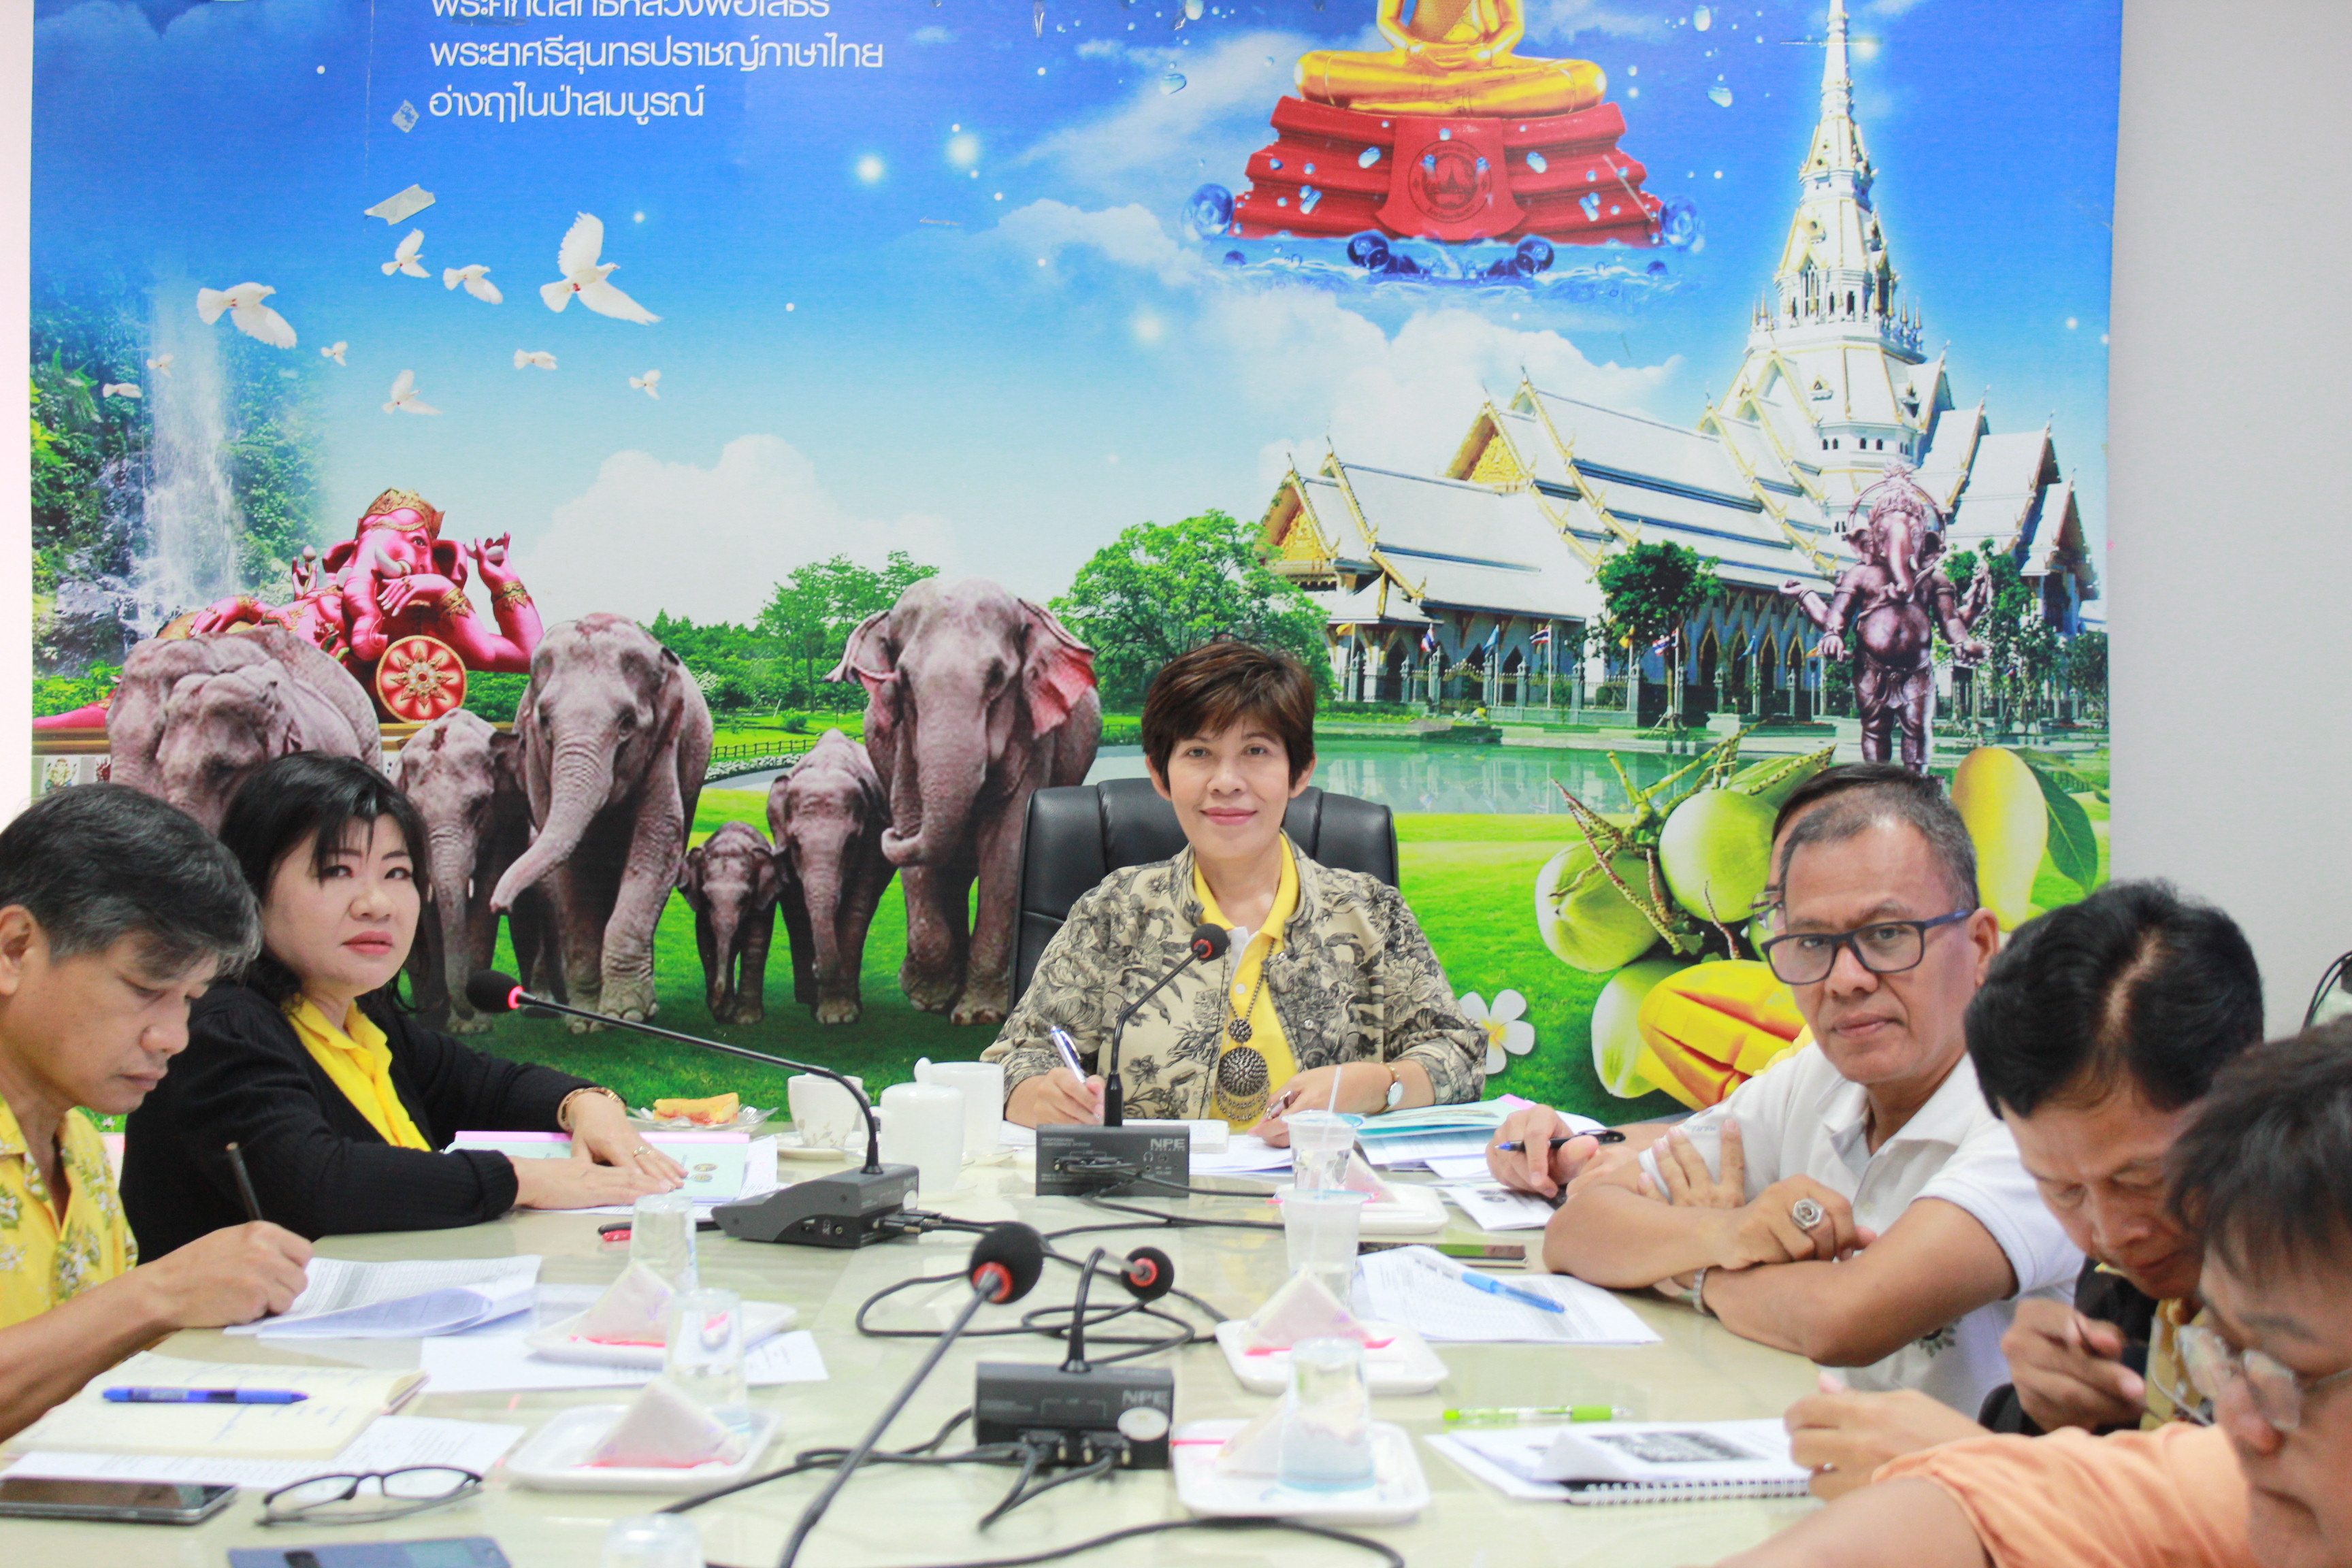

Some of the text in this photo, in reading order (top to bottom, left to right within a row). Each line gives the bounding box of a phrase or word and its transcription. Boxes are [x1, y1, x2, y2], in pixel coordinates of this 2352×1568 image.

[429, 32, 883, 76] พระยาศรีสุนทรปราชญ์ภาษาไทย
[1150, 1138, 1186, 1148] NPE
[1122, 1389, 1169, 1407] NPE
